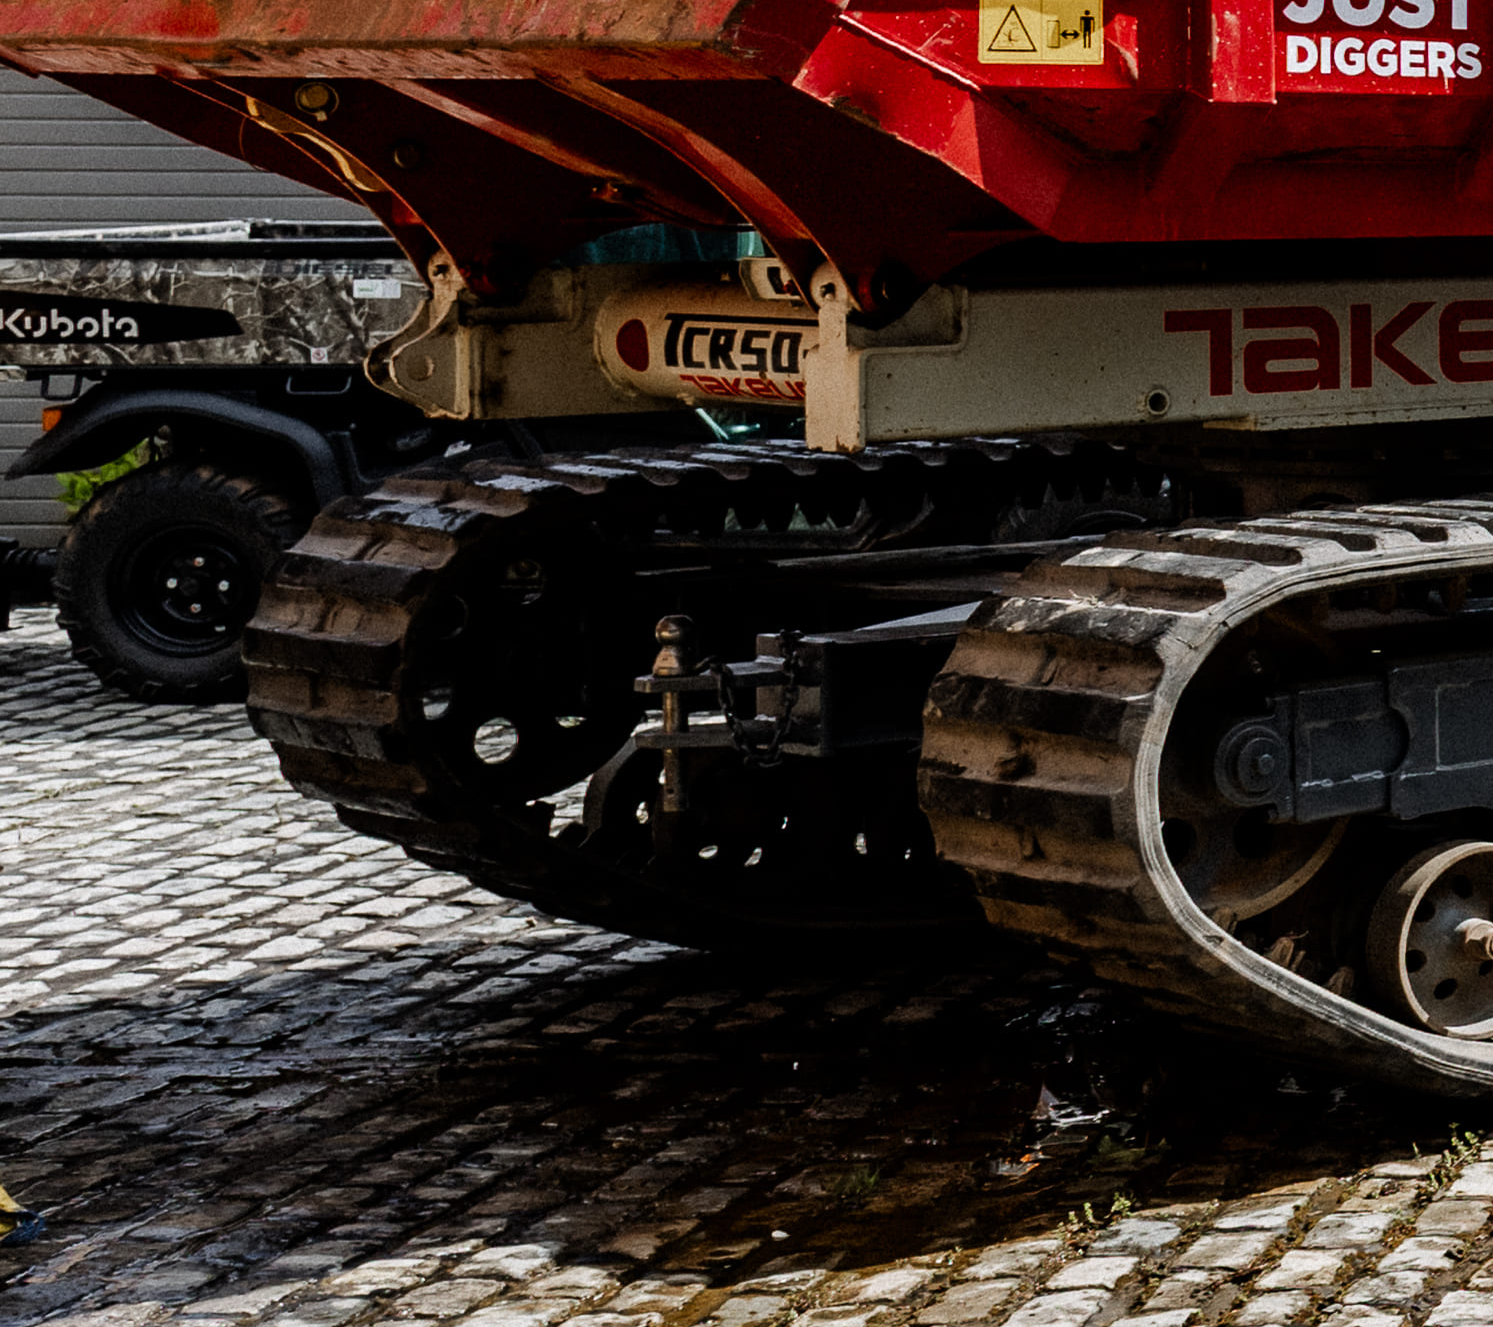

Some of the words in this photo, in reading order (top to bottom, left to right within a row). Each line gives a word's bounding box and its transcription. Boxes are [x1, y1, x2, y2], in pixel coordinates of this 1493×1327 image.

[1286, 35, 1483, 79] DIGGERS
[0, 308, 139, 338] Kubota
[664, 313, 818, 374] TCR50
[680, 375, 806, 401] TAKEU
